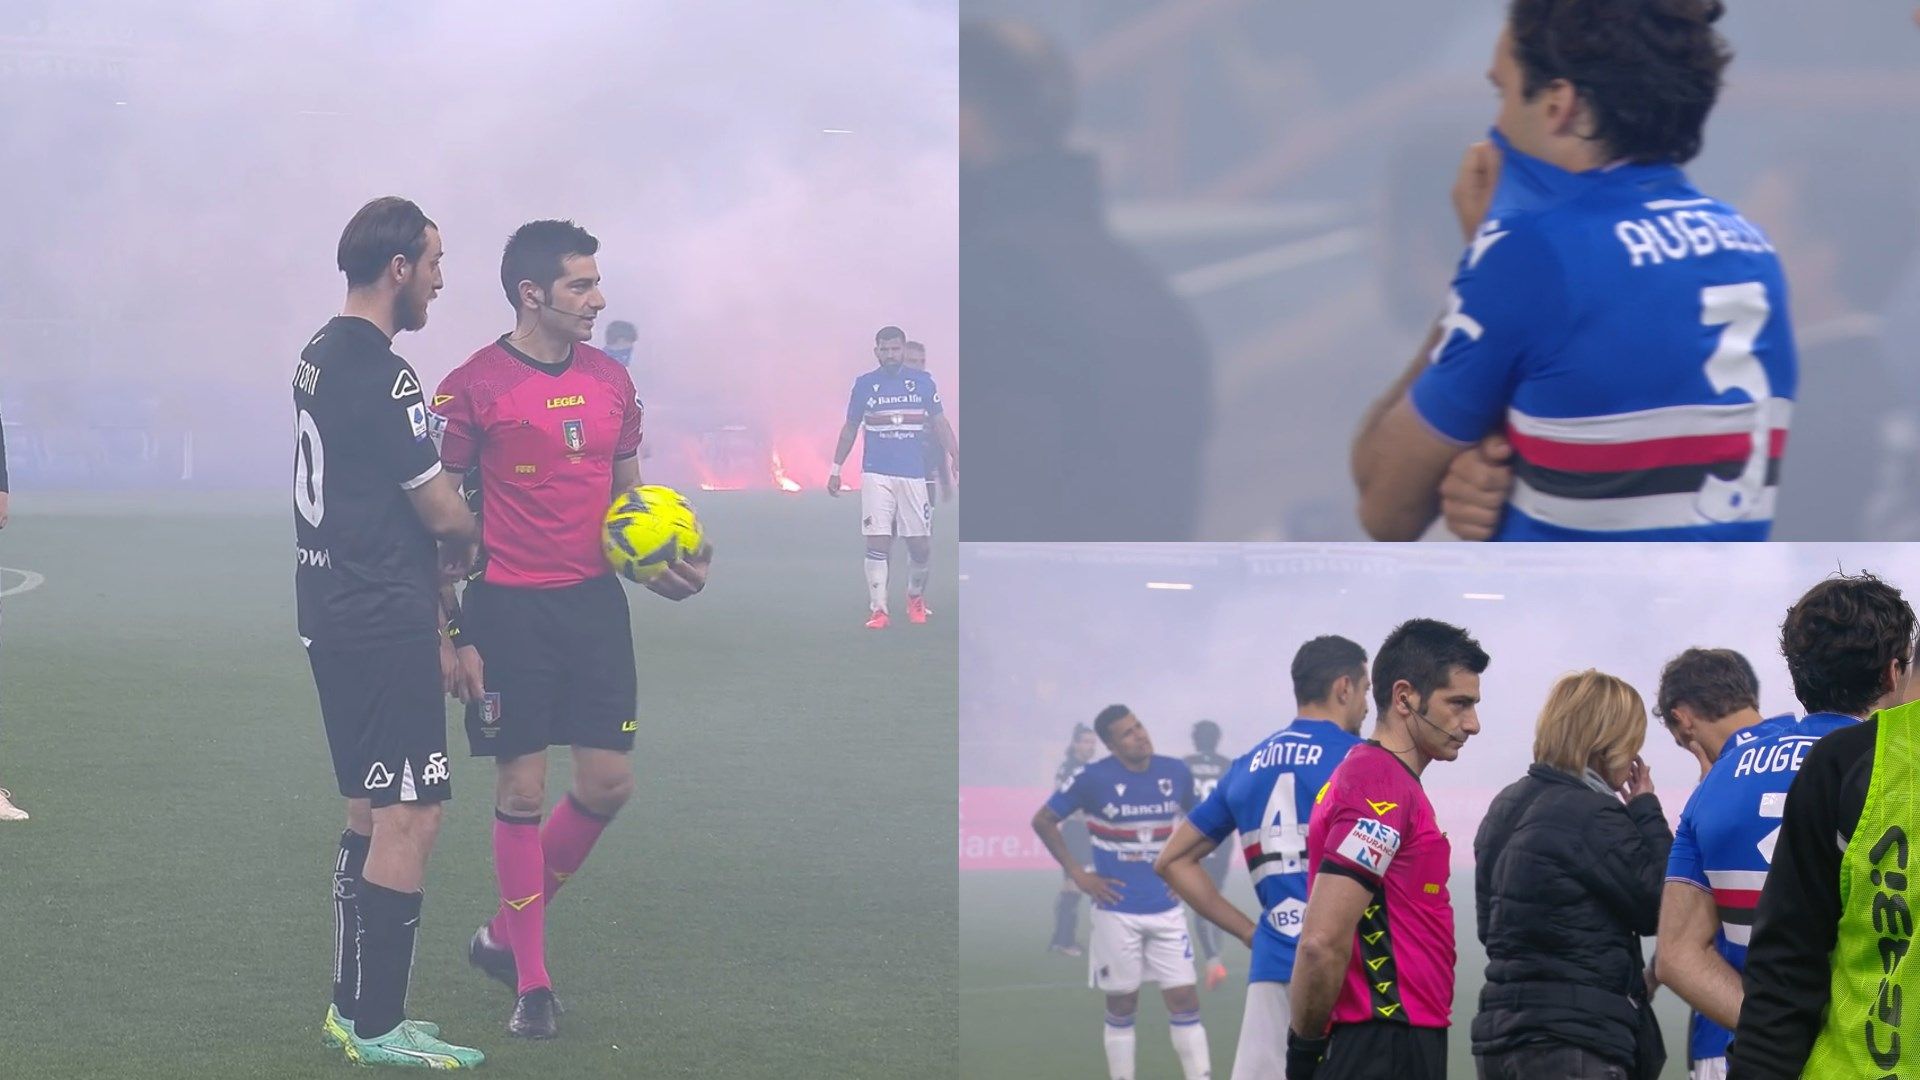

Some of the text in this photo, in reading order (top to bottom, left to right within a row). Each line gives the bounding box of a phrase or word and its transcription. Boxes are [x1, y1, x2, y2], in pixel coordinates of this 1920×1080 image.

[546, 394, 586, 409] LEGEA
[1698, 281, 1772, 522] 3
[1260, 772, 1308, 874] 4
[1358, 820, 1400, 849] NET
